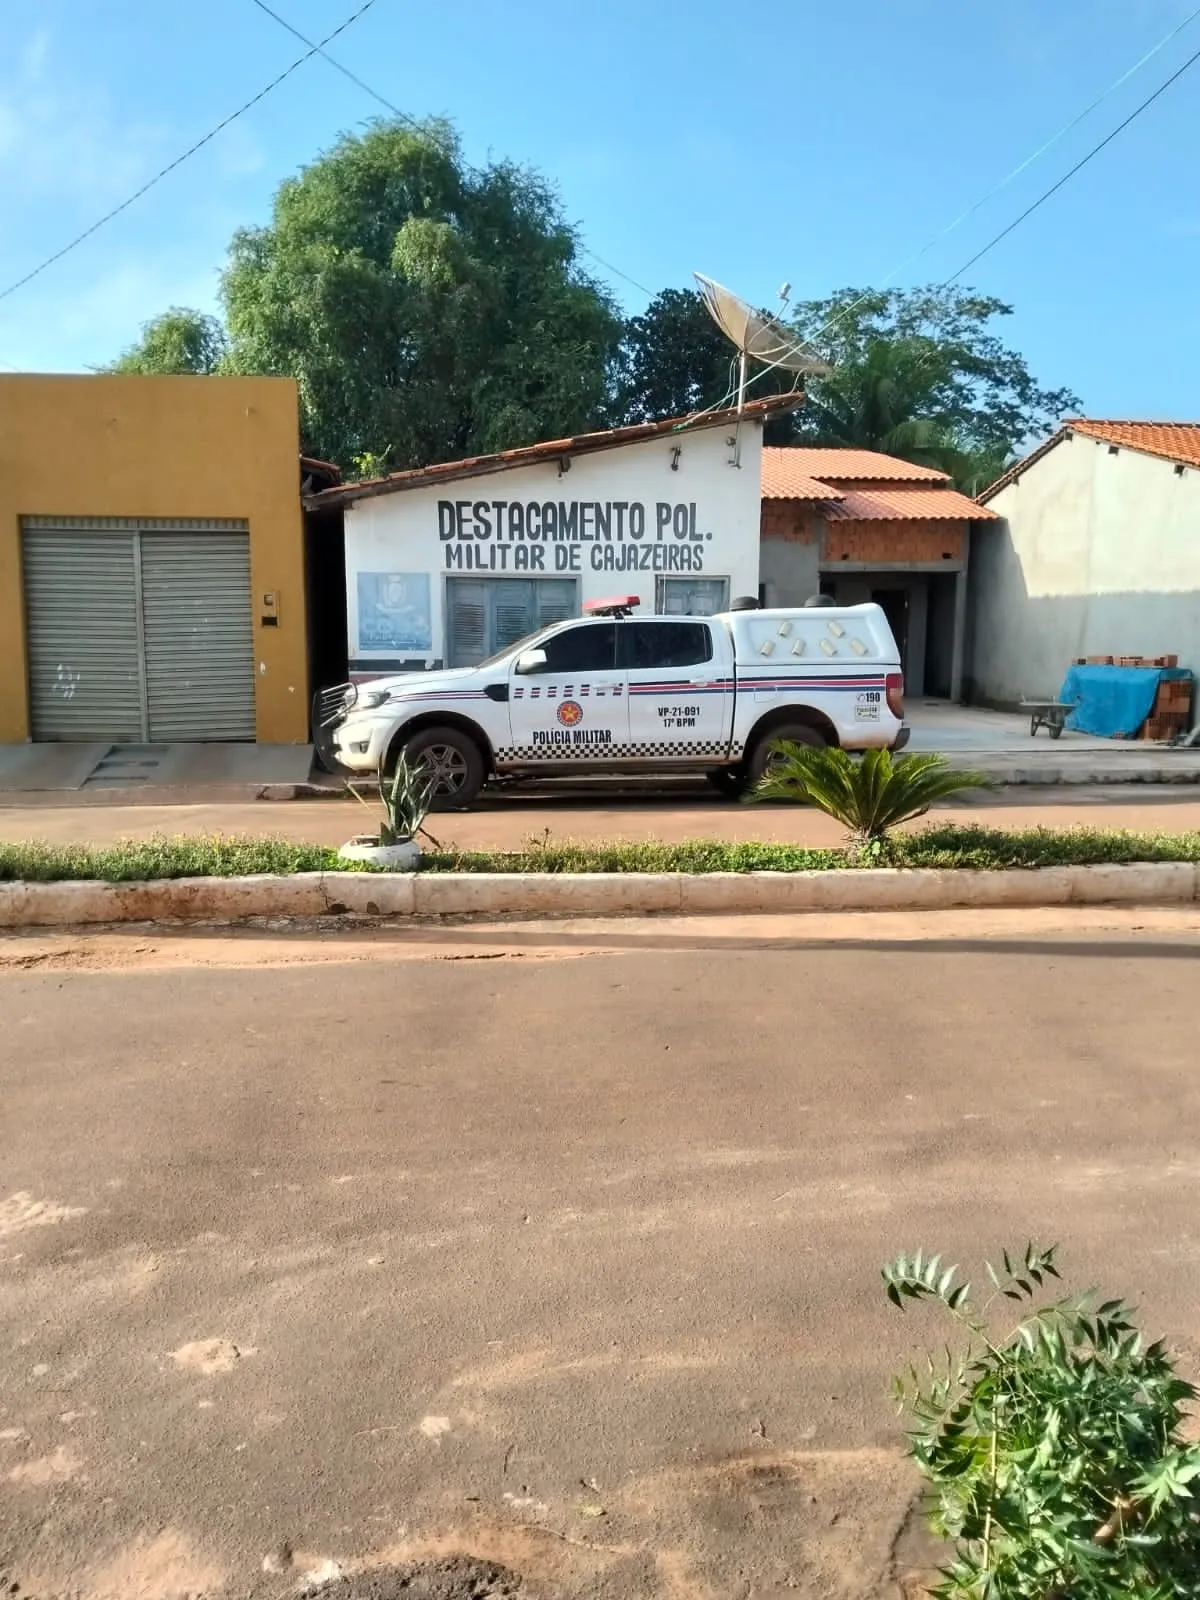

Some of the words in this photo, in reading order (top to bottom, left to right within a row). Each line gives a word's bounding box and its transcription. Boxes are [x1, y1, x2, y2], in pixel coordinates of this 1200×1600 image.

[437, 500, 646, 541] DESTACAMENTO
[656, 502, 713, 541] POL.
[445, 544, 546, 570] MILITAR
[554, 544, 582, 571] DE
[590, 544, 705, 571] CAJAZEIRAS
[866, 692, 881, 703] 190
[658, 706, 700, 717] VP-21-091
[676, 717, 696, 728] BPM
[532, 727, 571, 745] POLÍCIA
[573, 729, 612, 745] MILITAR
